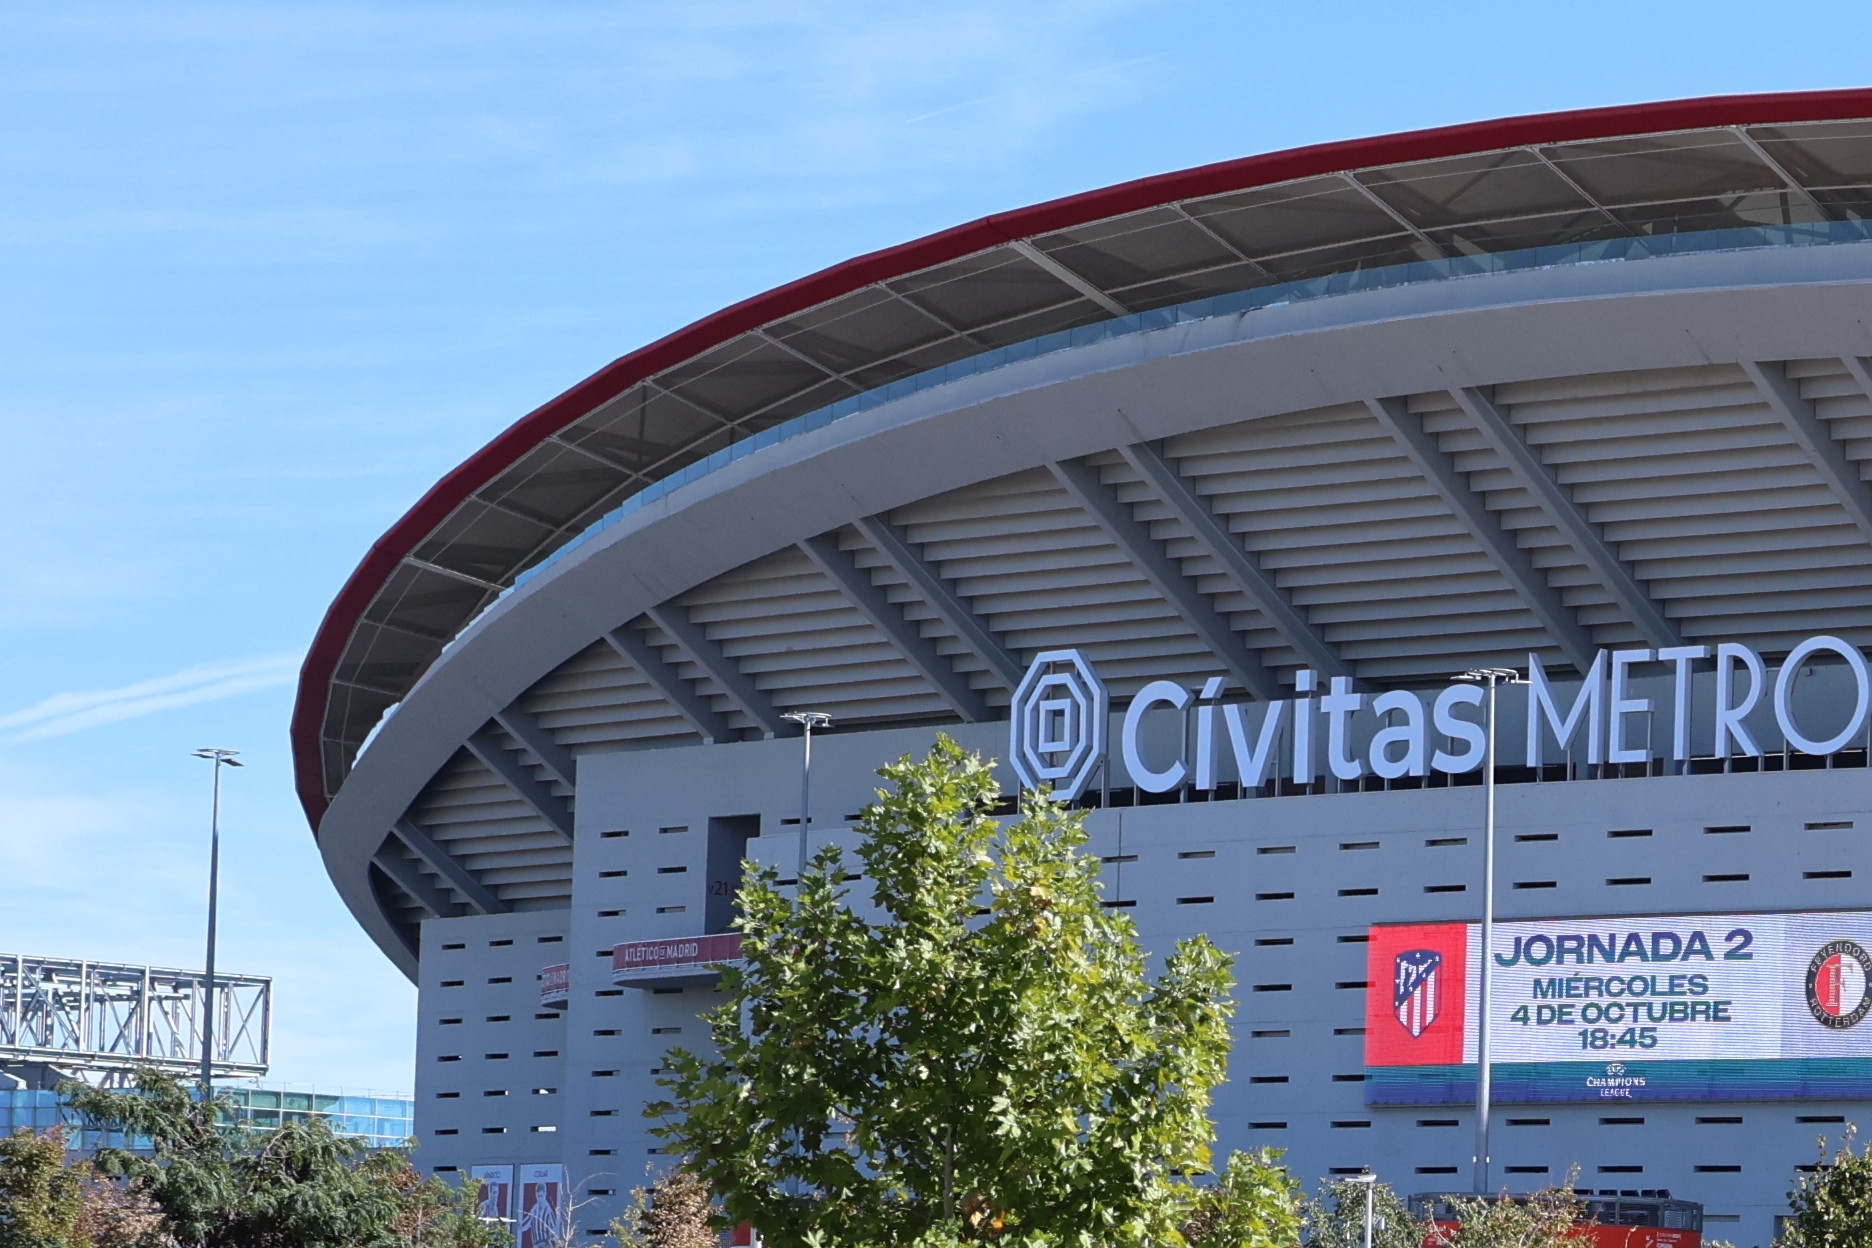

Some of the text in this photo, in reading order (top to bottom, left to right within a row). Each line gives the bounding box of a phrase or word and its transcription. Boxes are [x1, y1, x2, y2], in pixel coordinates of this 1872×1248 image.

[1122, 670, 1487, 794] Cívitas
[625, 944, 658, 962] ATLÉTICO
[666, 943, 699, 958] MADRID
[1494, 927, 1754, 967] JORNADA 2
[1532, 972, 1709, 999] MIÉRCOLES
[1510, 1000, 1732, 1026] 4 DE OCTUBRE
[1577, 1027, 1659, 1050] 18:45
[1586, 1076, 1646, 1087] CHAMPIONS
